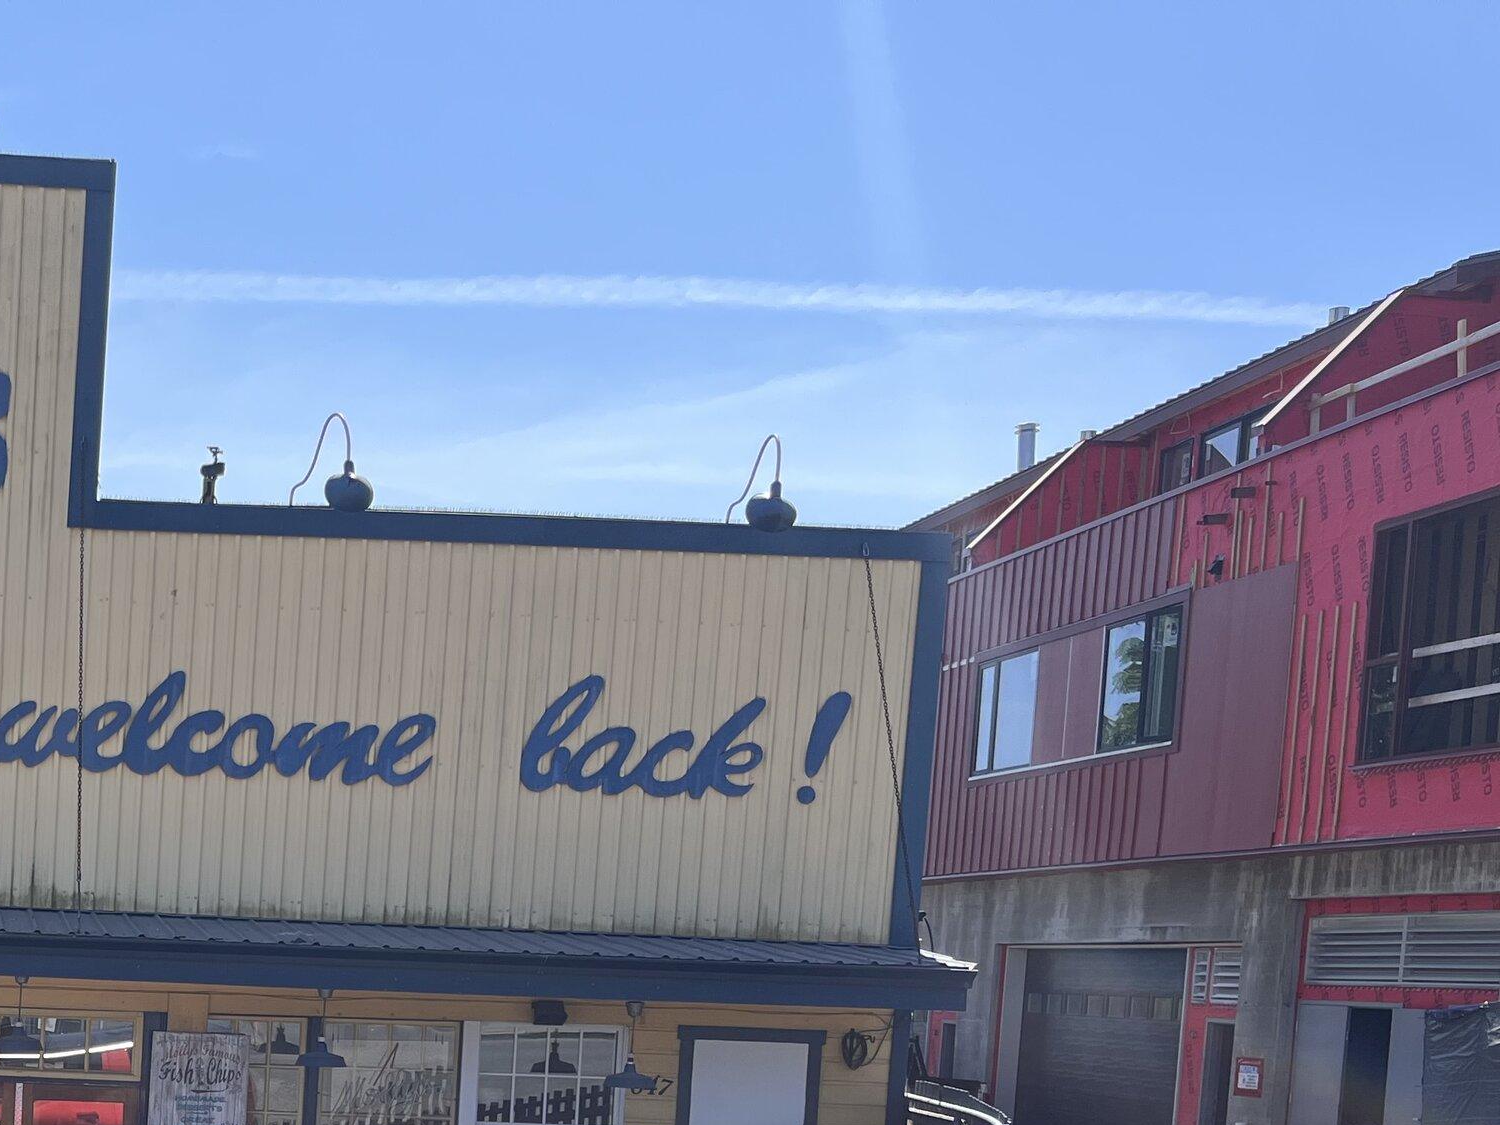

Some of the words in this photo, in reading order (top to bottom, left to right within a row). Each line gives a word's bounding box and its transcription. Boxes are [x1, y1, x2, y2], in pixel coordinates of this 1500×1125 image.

[1396, 431, 1413, 493] RESISTO
[1430, 424, 1446, 487] RESISTO
[1460, 408, 1477, 475] RESISTO
[1316, 463, 1329, 522] RESISTO
[1341, 451, 1355, 512] RESISTO
[1371, 444, 1386, 505] RESISTO
[1303, 551, 1315, 607] RESISTO
[1331, 543, 1344, 600] RESISTO
[1354, 640, 1363, 690] RESIST
[159, 1058, 195, 1085] Fish
[206, 1057, 242, 1090] Chips
